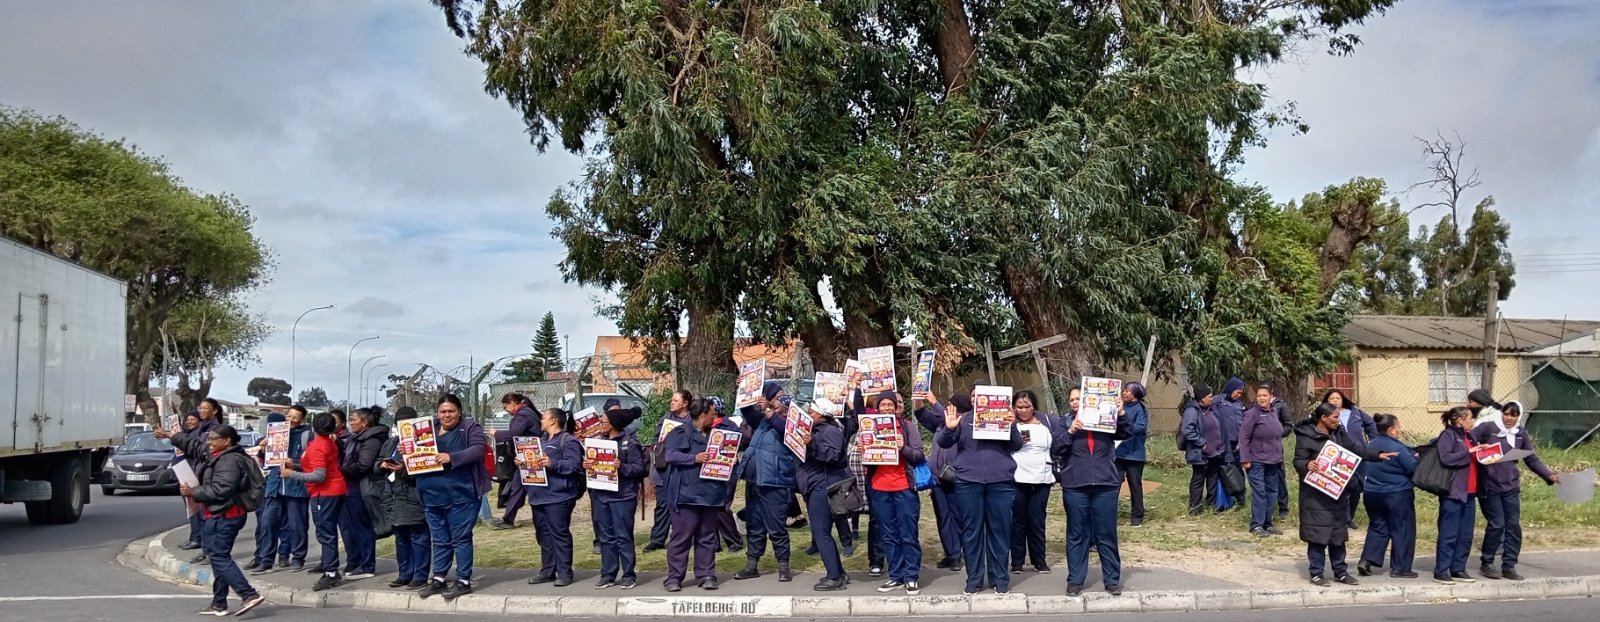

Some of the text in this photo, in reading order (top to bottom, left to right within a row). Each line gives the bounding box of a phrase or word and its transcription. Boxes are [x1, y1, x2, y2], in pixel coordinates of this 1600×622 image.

[1311, 472, 1341, 491] ABSORPTION
[1316, 479, 1326, 487] ALL
[672, 602, 756, 614] TAFELBERG RD
